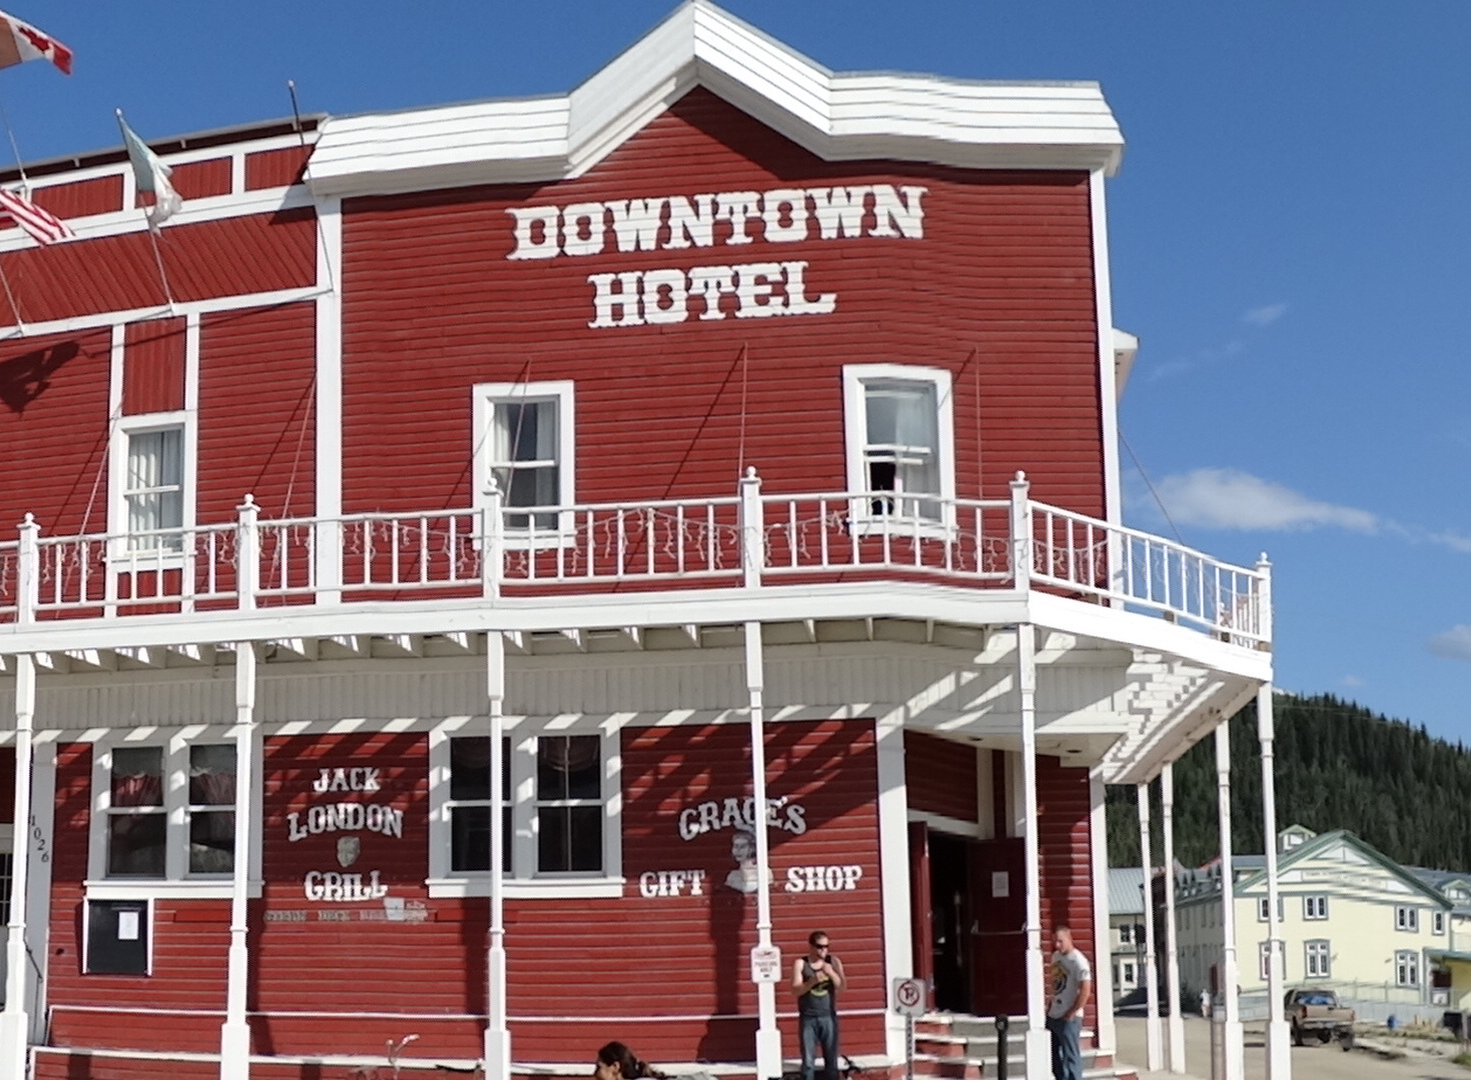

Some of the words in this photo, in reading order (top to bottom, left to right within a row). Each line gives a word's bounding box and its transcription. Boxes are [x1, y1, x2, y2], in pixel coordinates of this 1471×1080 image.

[504, 184, 929, 261] DOWNTOWN
[587, 261, 838, 328] HOTEL
[313, 767, 381, 793] JACK
[31, 815, 50, 863] 1026
[287, 802, 404, 841] LONDON
[304, 870, 389, 902] GRILL
[639, 870, 706, 898] GIFT
[785, 865, 863, 893] SHOP
